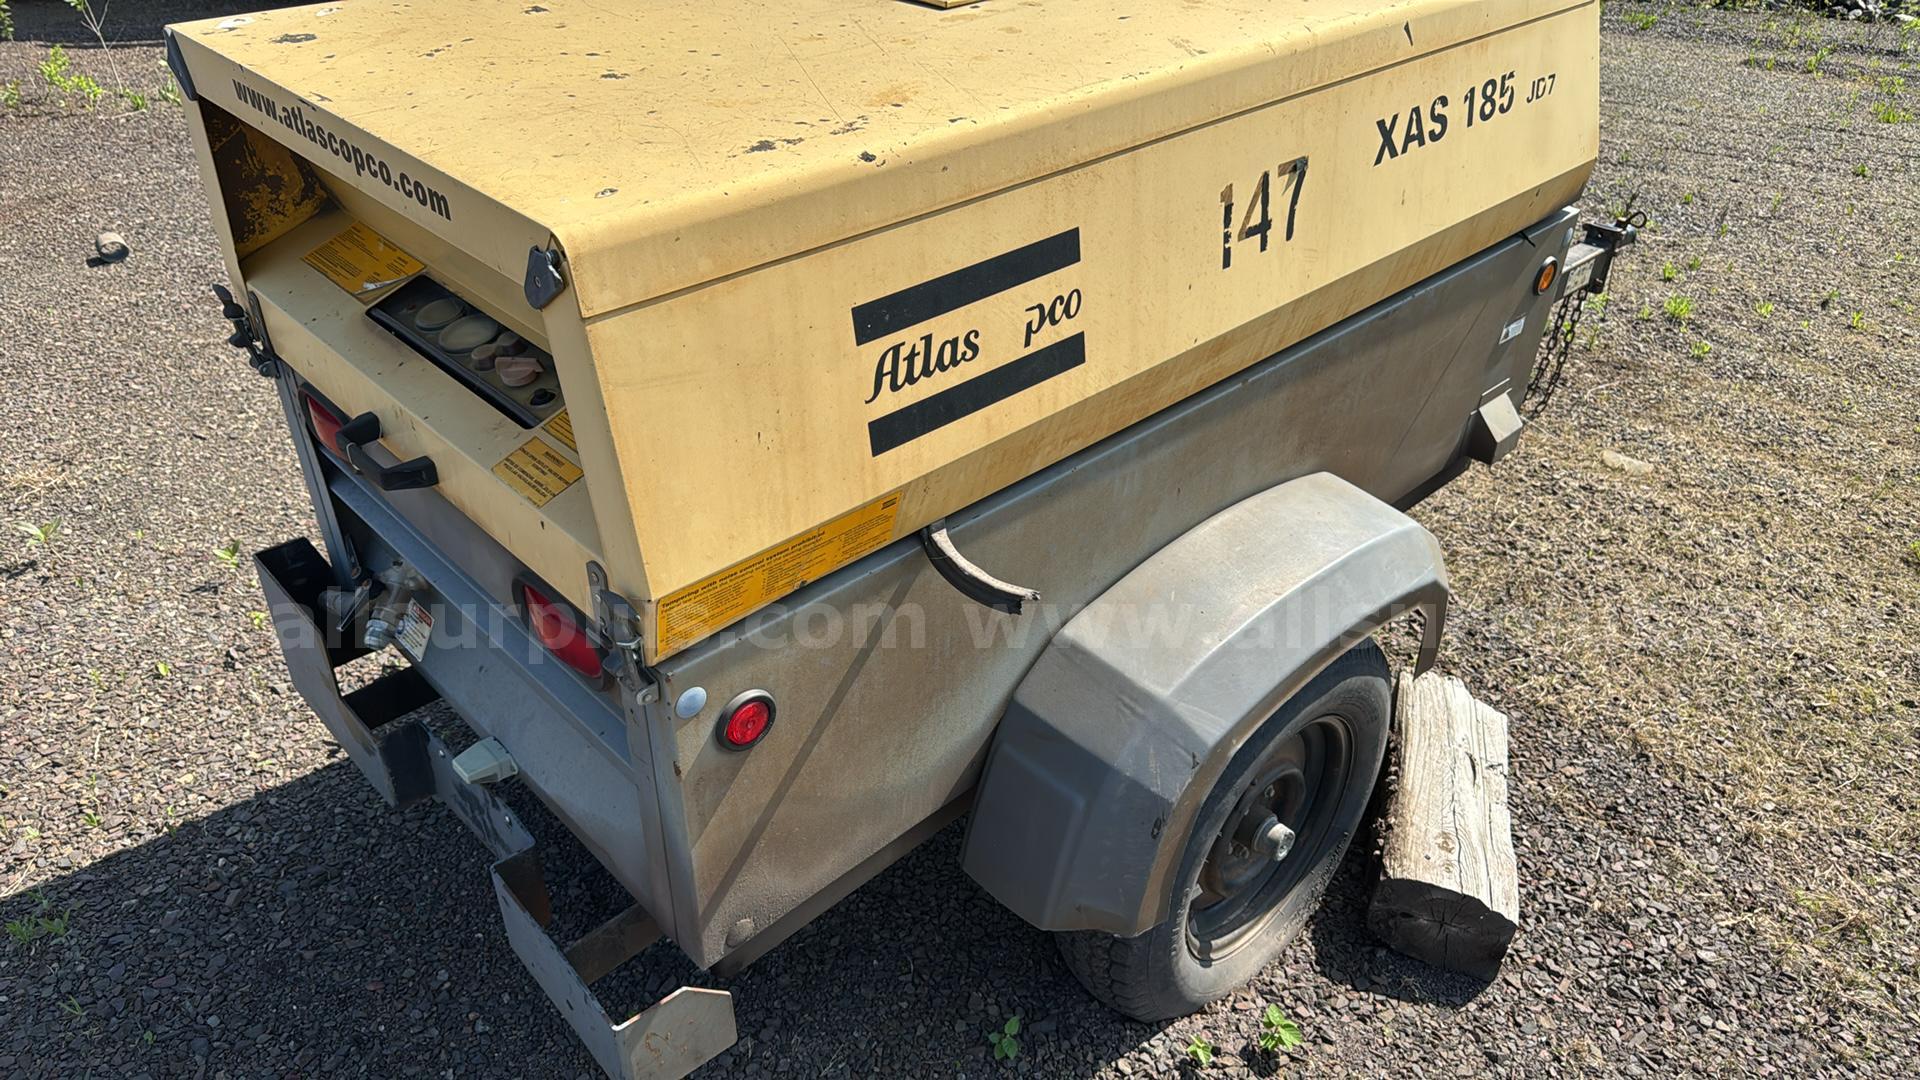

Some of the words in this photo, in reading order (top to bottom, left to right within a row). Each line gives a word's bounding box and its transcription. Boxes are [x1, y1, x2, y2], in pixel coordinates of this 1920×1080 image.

[232, 78, 452, 221] www.atlascopco.com
[1373, 94, 1449, 167] XAS
[1463, 70, 1515, 128] 185
[1525, 73, 1556, 104] JD7
[1219, 154, 1310, 271] 147
[865, 329, 980, 404] Atlas
